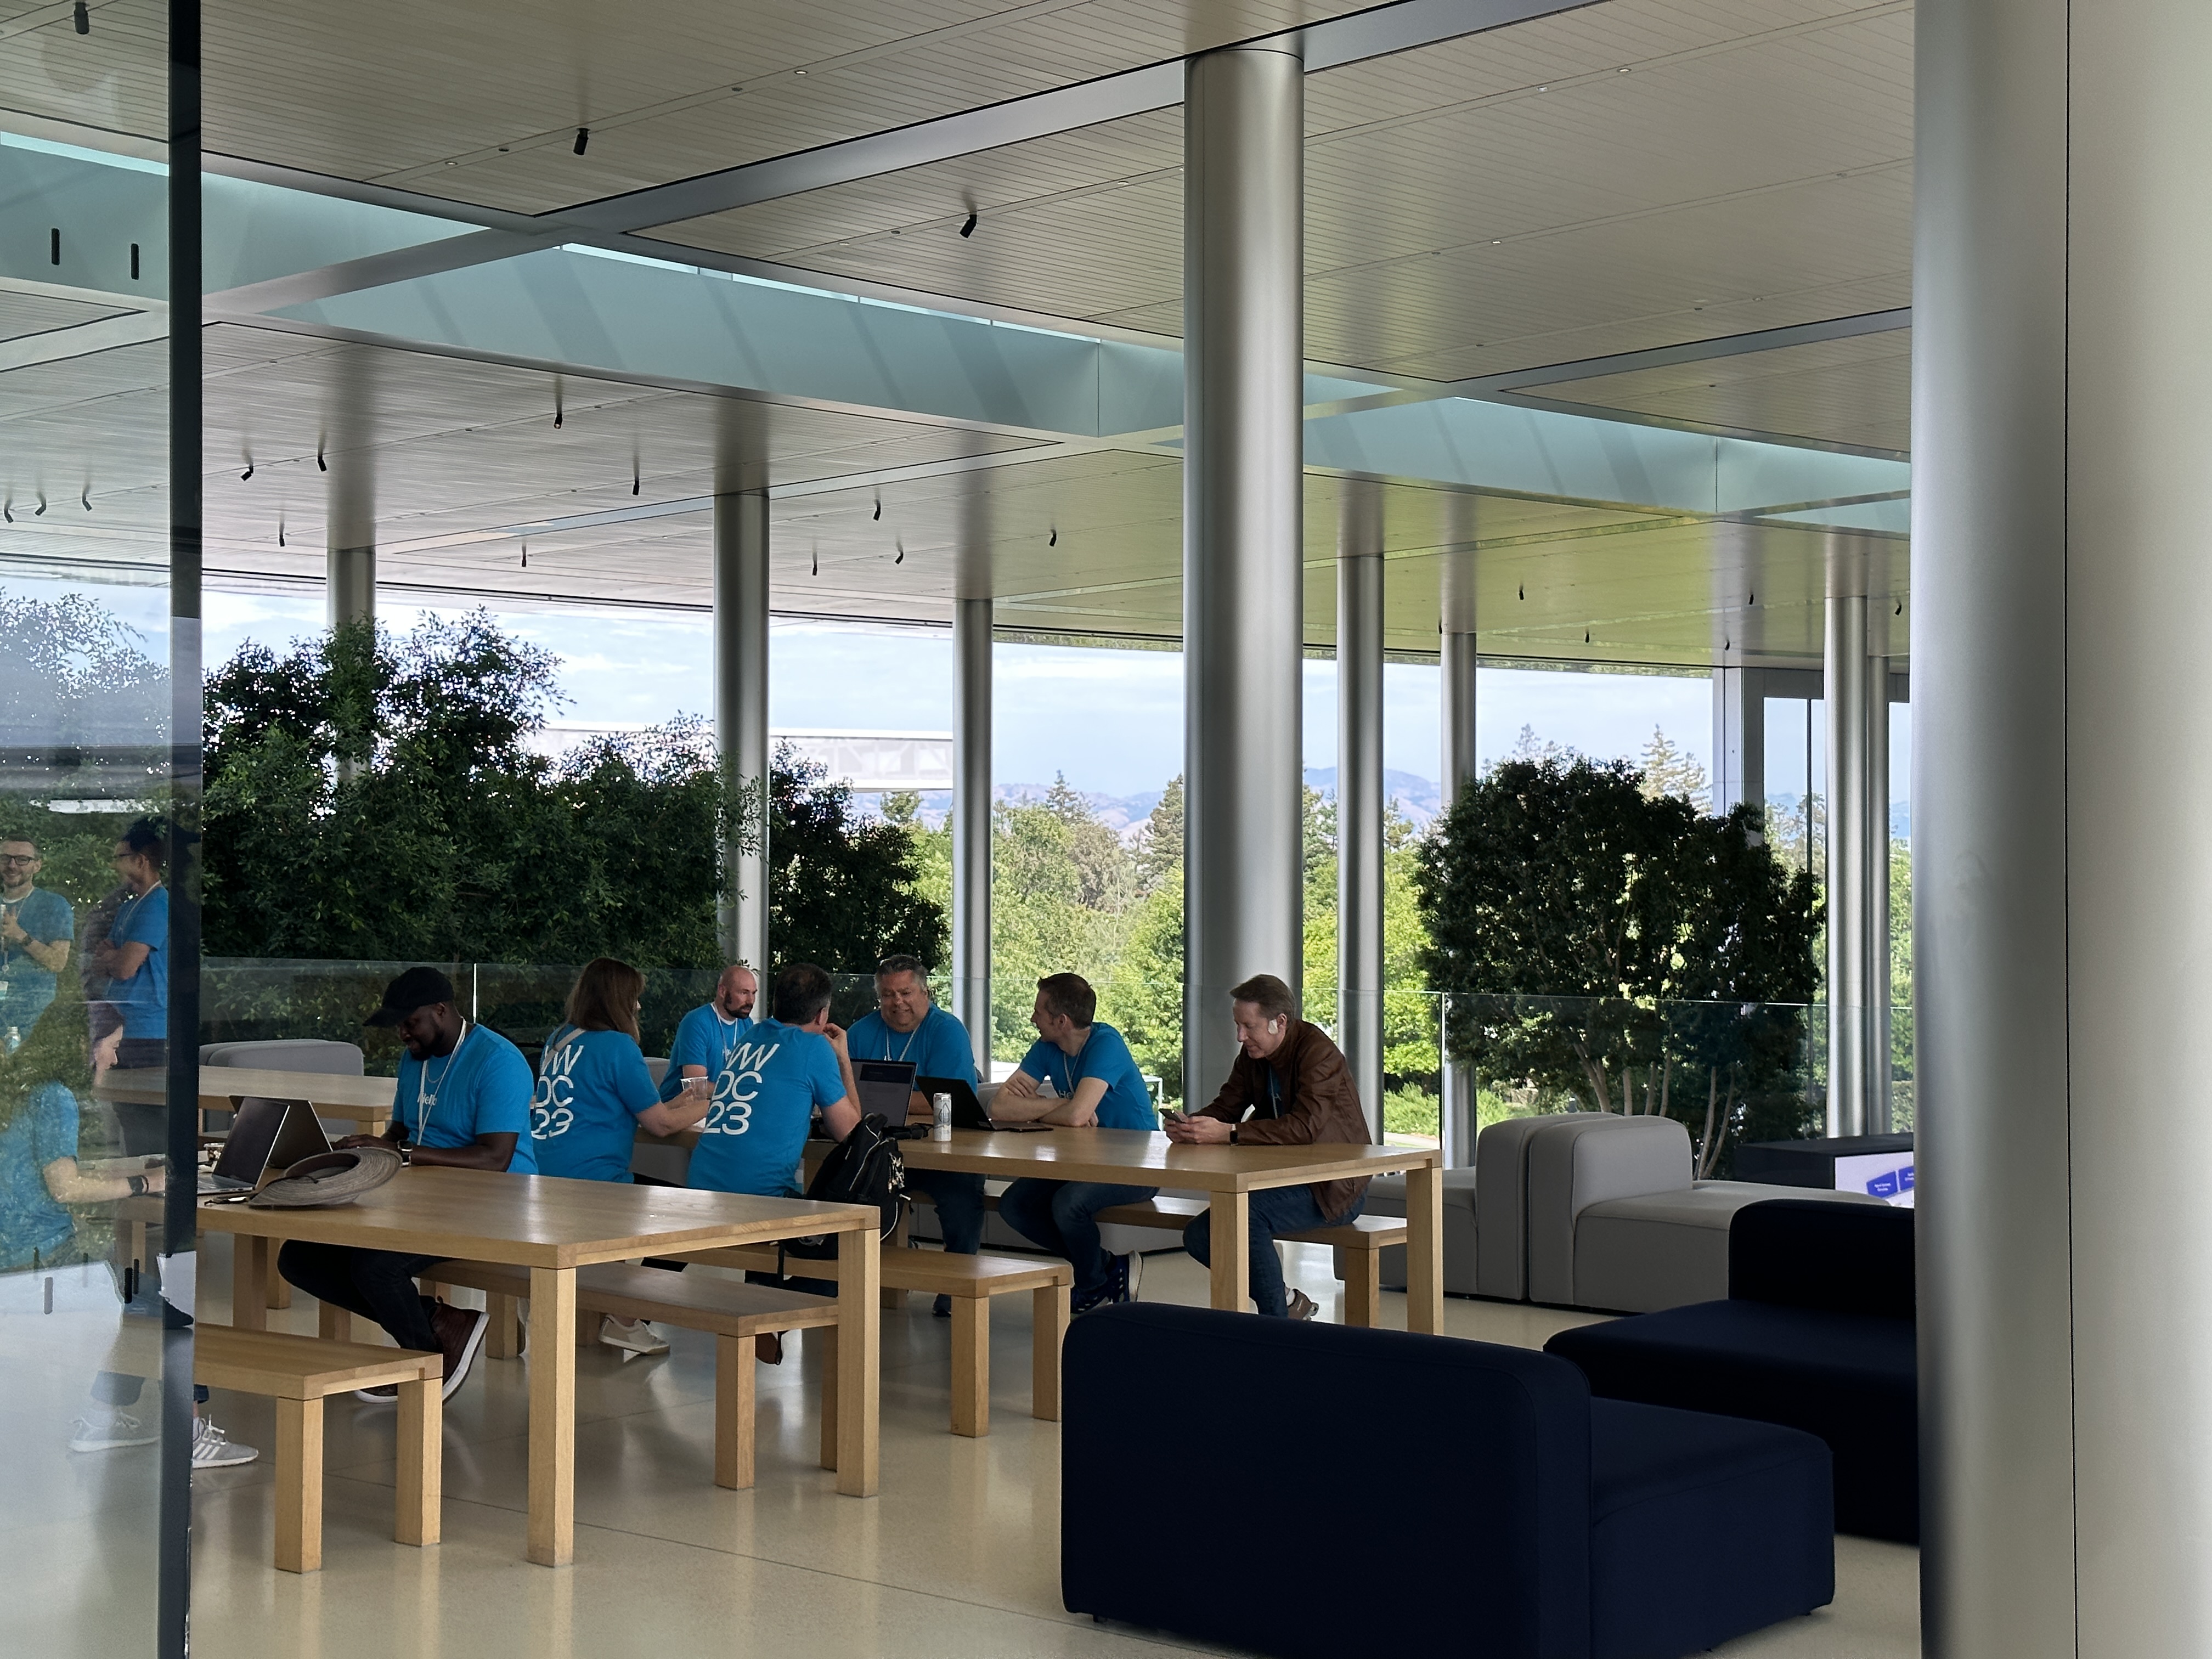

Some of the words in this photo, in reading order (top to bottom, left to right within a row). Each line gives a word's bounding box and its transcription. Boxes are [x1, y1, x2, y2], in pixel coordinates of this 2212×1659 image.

[535, 1075, 574, 1107] DC
[712, 1070, 763, 1101] DC
[531, 1108, 574, 1139] 23
[703, 1101, 752, 1135] 23
